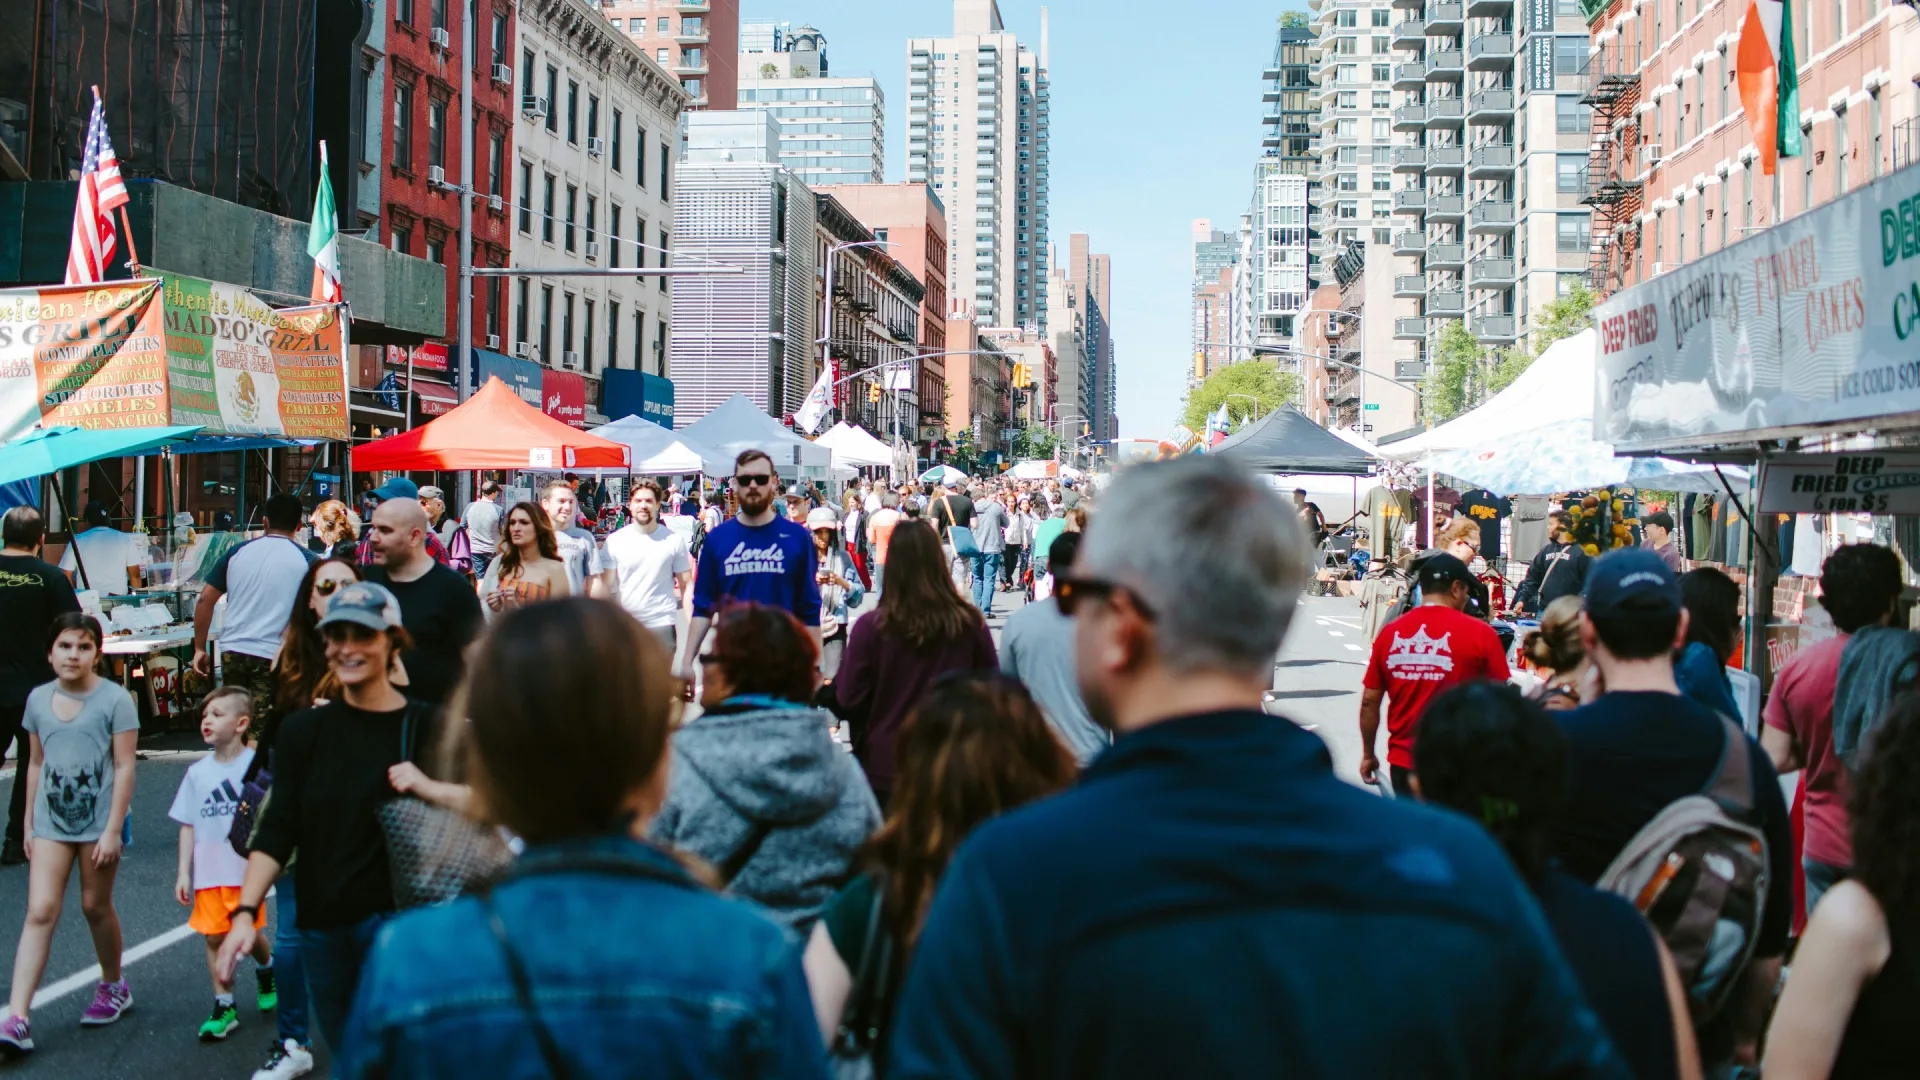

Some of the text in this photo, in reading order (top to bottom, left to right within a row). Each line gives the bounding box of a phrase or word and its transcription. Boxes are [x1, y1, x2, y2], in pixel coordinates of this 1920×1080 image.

[1754, 235, 1820, 315] FUNNEL
[1669, 272, 1741, 350] ZEPPOLES
[1806, 276, 1864, 352] CAKES
[22, 311, 145, 346] GRILL
[1602, 303, 1658, 355] DEEP FRIED
[39, 337, 160, 362] COMBO PLATTERS
[95, 358, 126, 370] CARNE
[127, 354, 158, 367] ASADA
[295, 355, 339, 367] PLATTERS
[42, 376, 83, 391] CHIPOTLE
[116, 370, 137, 383] TACO
[137, 367, 163, 380] SALAD
[1862, 366, 1896, 394] COLD
[1898, 361, 1920, 390] SO
[44, 382, 164, 405] SIDE ORDERS
[57, 397, 157, 418] TAMELES
[285, 404, 338, 414] TAMELES
[105, 411, 168, 428] NACHOS
[1836, 457, 1885, 474] DEEP
[320, 483, 328, 494] P
[1792, 475, 1849, 492] FRIED
[1470, 504, 1498, 519] nyc
[1828, 498, 1857, 510] FOR
[1861, 493, 1888, 511] $5
[725, 541, 784, 564] Lords
[725, 561, 785, 576] BASEBALL
[200, 803, 237, 818] adida
